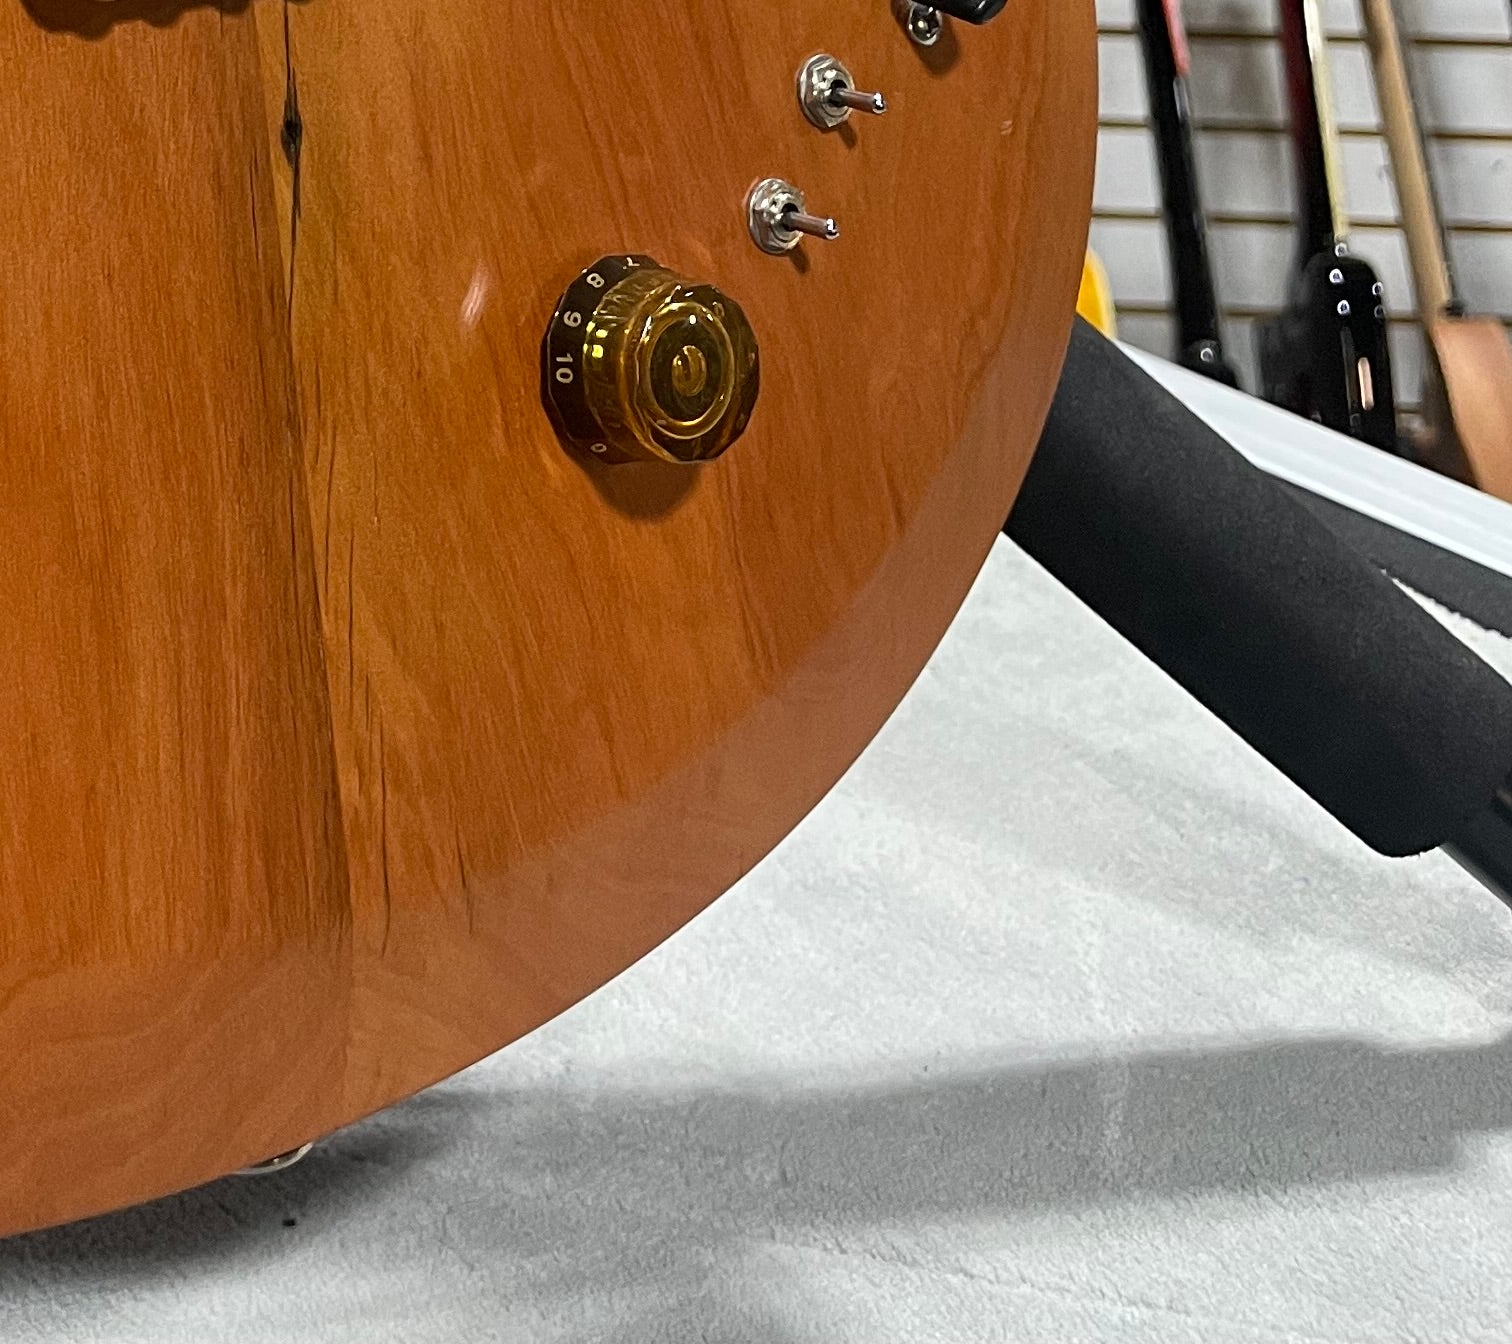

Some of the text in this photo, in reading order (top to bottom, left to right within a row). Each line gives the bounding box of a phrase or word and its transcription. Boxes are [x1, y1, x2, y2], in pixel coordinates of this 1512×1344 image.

[586, 272, 606, 289] 8
[563, 310, 583, 328] 9
[555, 352, 575, 385] 10
[590, 442, 608, 454] 0
